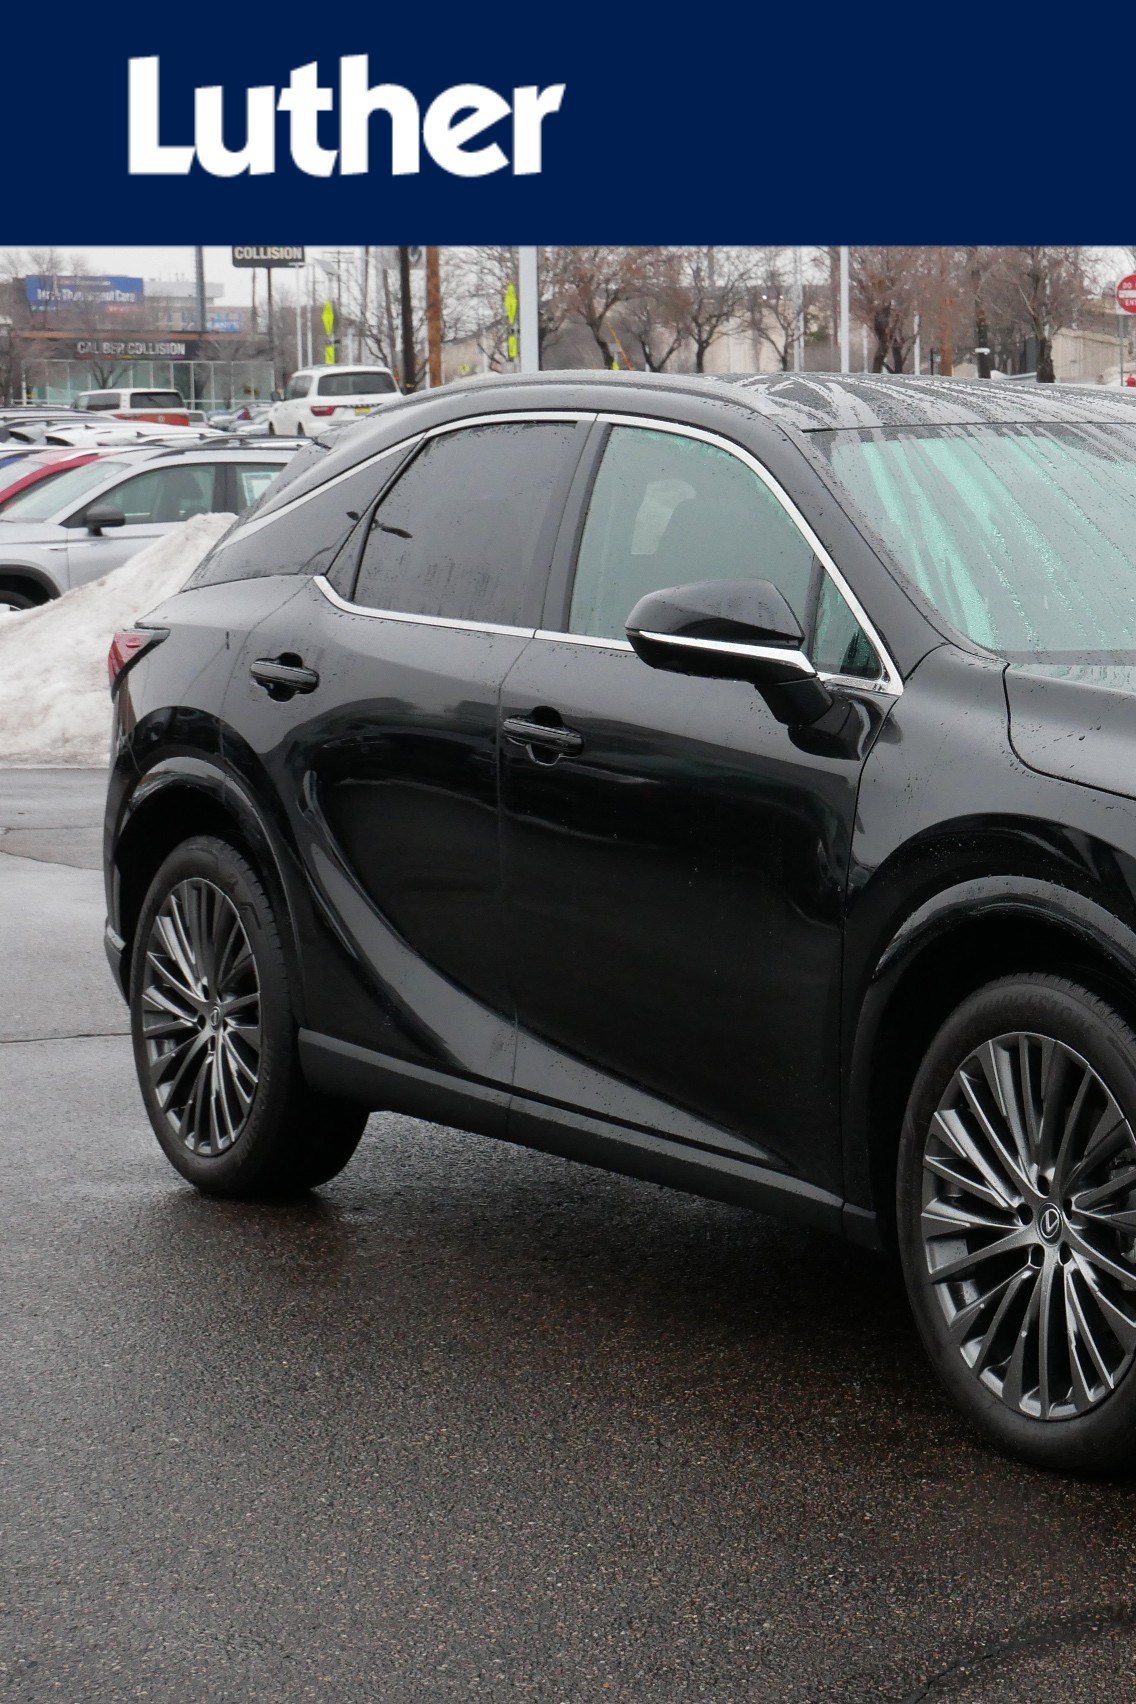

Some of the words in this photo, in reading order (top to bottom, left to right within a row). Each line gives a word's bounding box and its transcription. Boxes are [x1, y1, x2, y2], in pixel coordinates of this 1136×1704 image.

[234, 246, 302, 260] COLLISION
[1122, 281, 1132, 289] DO
[77, 341, 125, 354] CALBER
[128, 342, 186, 355] COLLISION
